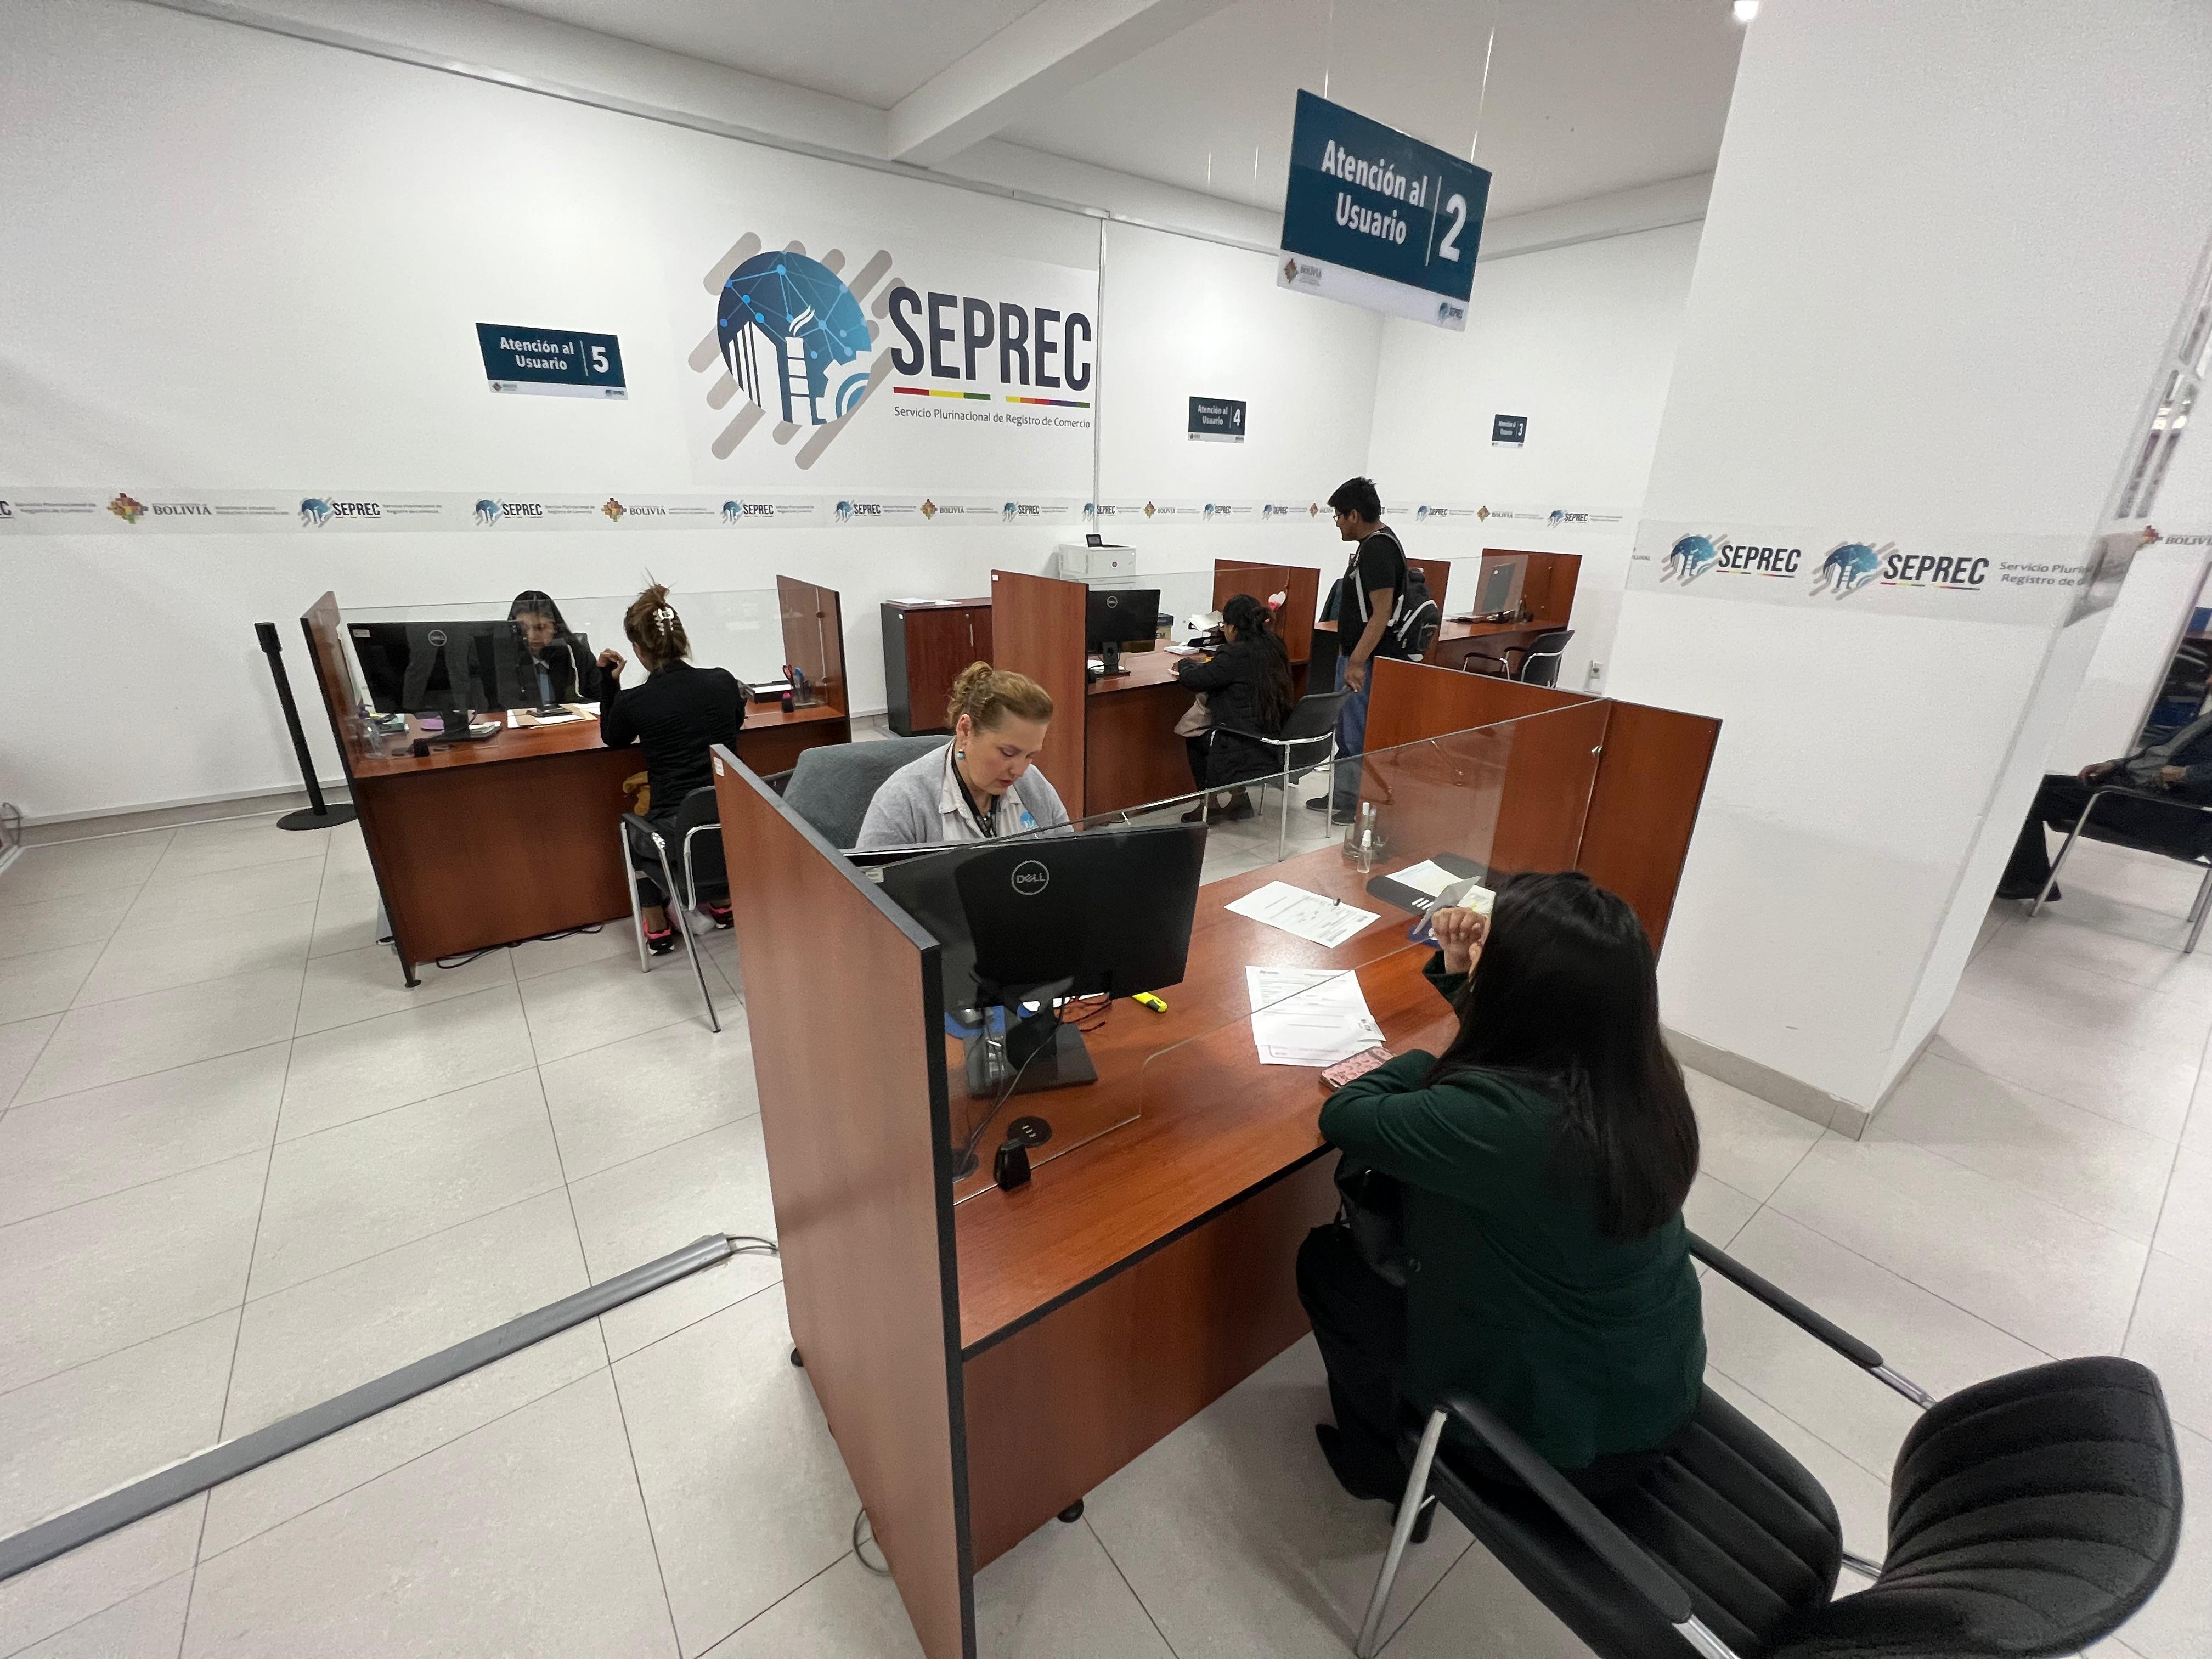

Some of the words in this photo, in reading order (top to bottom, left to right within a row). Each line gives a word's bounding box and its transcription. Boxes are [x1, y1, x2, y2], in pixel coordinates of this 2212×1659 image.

[1321, 139, 1407, 201] Atención
[1409, 176, 1428, 207] al
[1336, 192, 1407, 245] Usuario
[1439, 194, 1468, 262] 2
[889, 286, 1091, 391] SEPREC
[500, 337, 559, 354] Atención
[563, 342, 574, 354] al
[515, 354, 567, 370] Usuario
[591, 346, 610, 373] 5
[1198, 405, 1222, 414] Atención
[1223, 407, 1228, 415] al
[894, 407, 932, 418] Servicio
[934, 409, 991, 422] Plurinacional
[993, 413, 1003, 422] de
[1006, 414, 1040, 426] Registro
[1042, 417, 1052, 425] de
[1054, 417, 1090, 428] Comercio
[1202, 416, 1223, 425] Usuario
[1233, 409, 1241, 426] 4
[1518, 423, 1523, 436] 3
[153, 506, 212, 515] BOLIVIA
[332, 503, 380, 516] SEPREC
[503, 504, 543, 516] SEPREC
[743, 504, 774, 515] SEPREC
[854, 504, 881, 514] SEPREC
[1018, 505, 1040, 514] SEPREC
[1097, 505, 1115, 514] SEPREC
[1564, 513, 1589, 522] SEPREC
[2165, 537, 2212, 545] BOLIVI
[1719, 545, 1801, 573] SEPREC
[1883, 554, 1989, 585] SEPREC
[2000, 562, 2049, 572] Servicio
[2001, 574, 2055, 585] Registro
[2058, 578, 2075, 586] de
[1016, 873, 1046, 884] DELL
